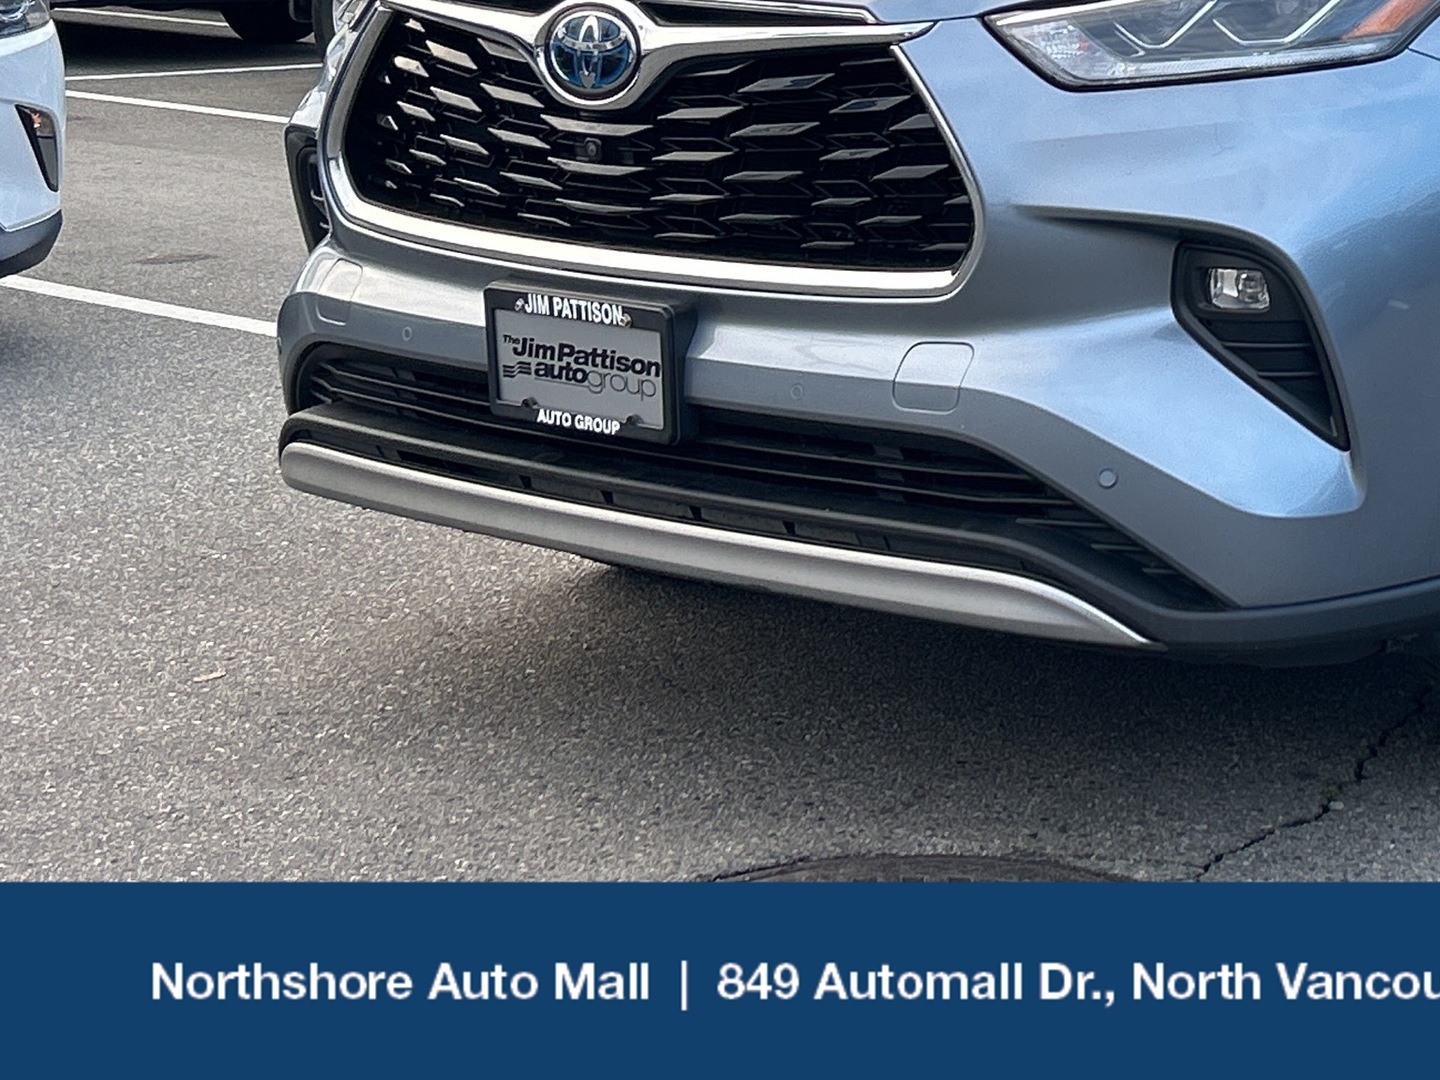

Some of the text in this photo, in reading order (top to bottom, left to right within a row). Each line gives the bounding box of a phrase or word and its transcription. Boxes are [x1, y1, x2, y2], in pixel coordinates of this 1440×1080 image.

[524, 293, 624, 325] JIM PATTISON
[503, 334, 521, 345] The
[537, 408, 621, 435] AUTO GROUP
